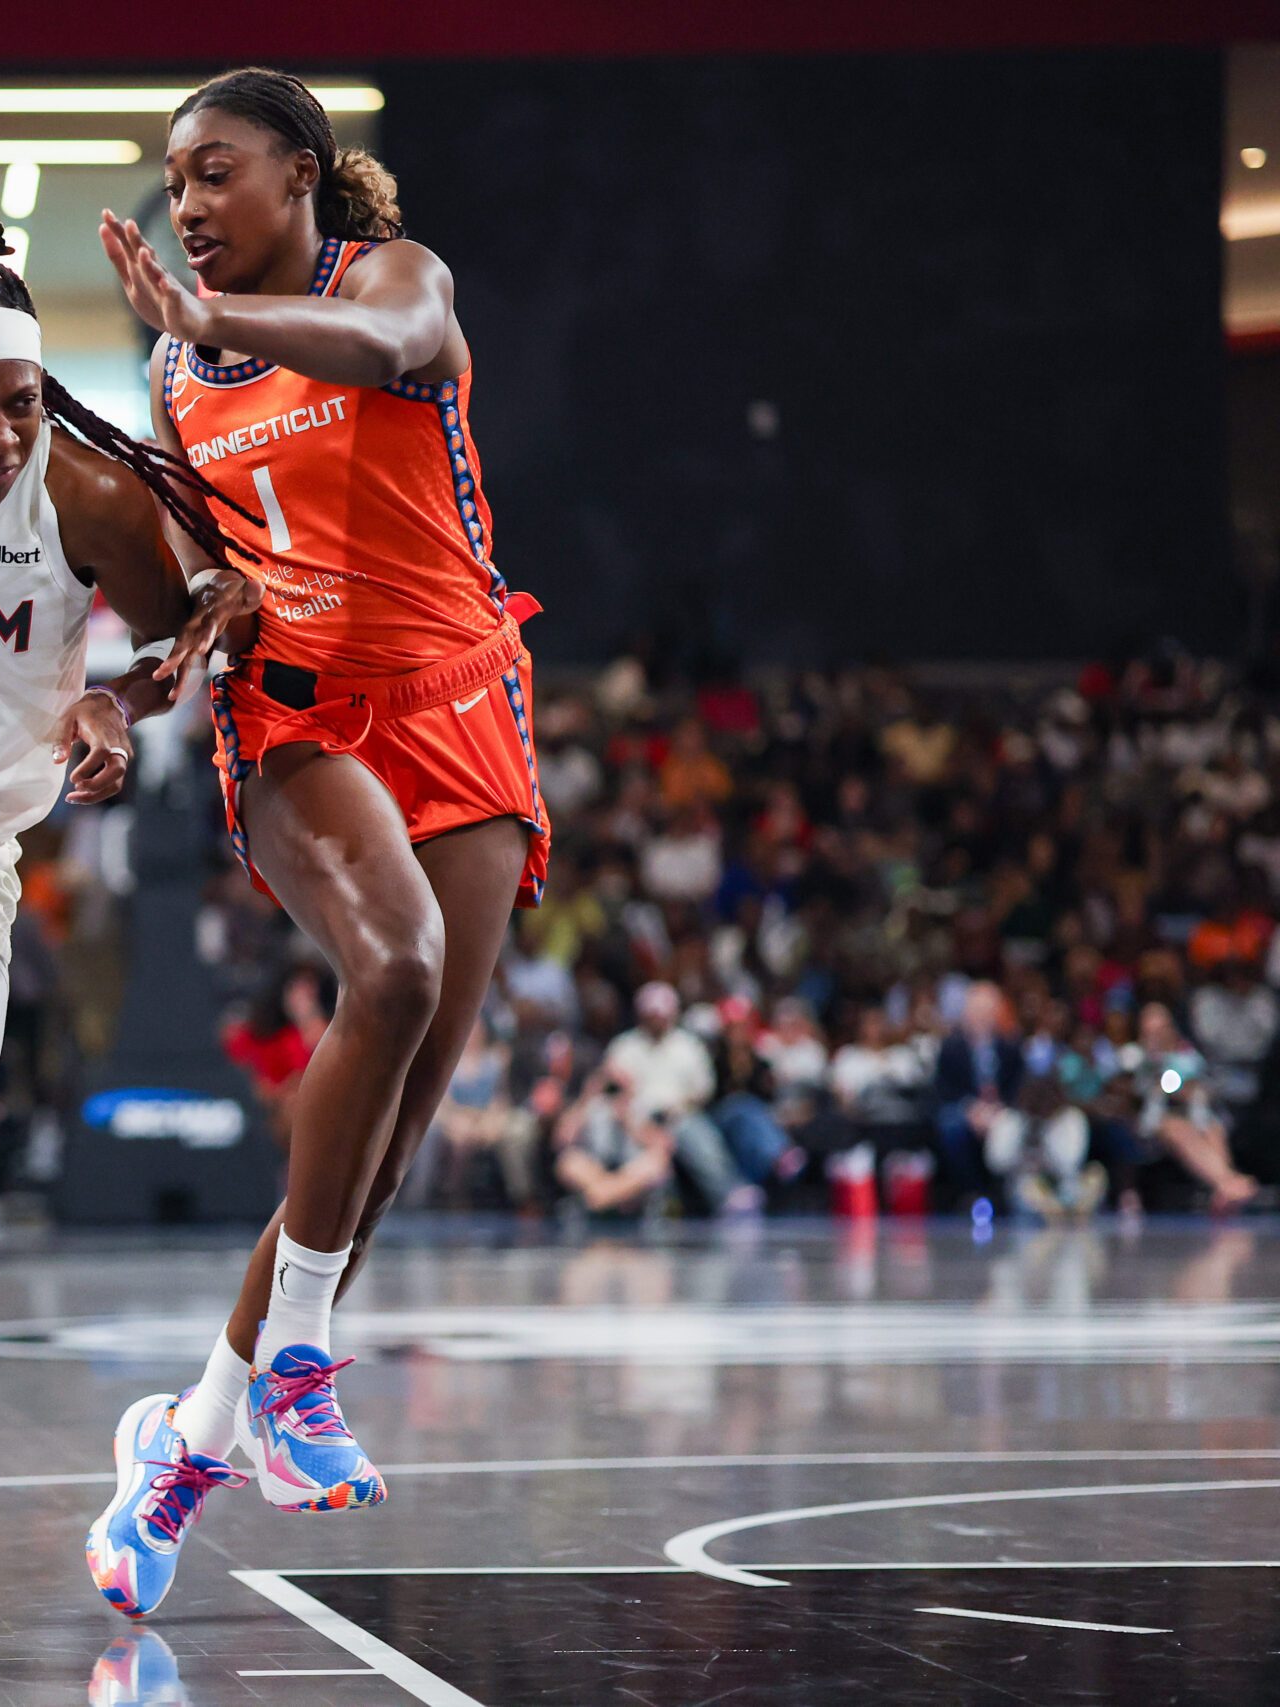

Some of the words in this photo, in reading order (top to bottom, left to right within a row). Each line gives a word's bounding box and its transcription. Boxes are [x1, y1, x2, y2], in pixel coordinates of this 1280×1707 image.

[252, 465, 292, 554] 1
[261, 564, 294, 585] Yale
[276, 592, 342, 623] Health
